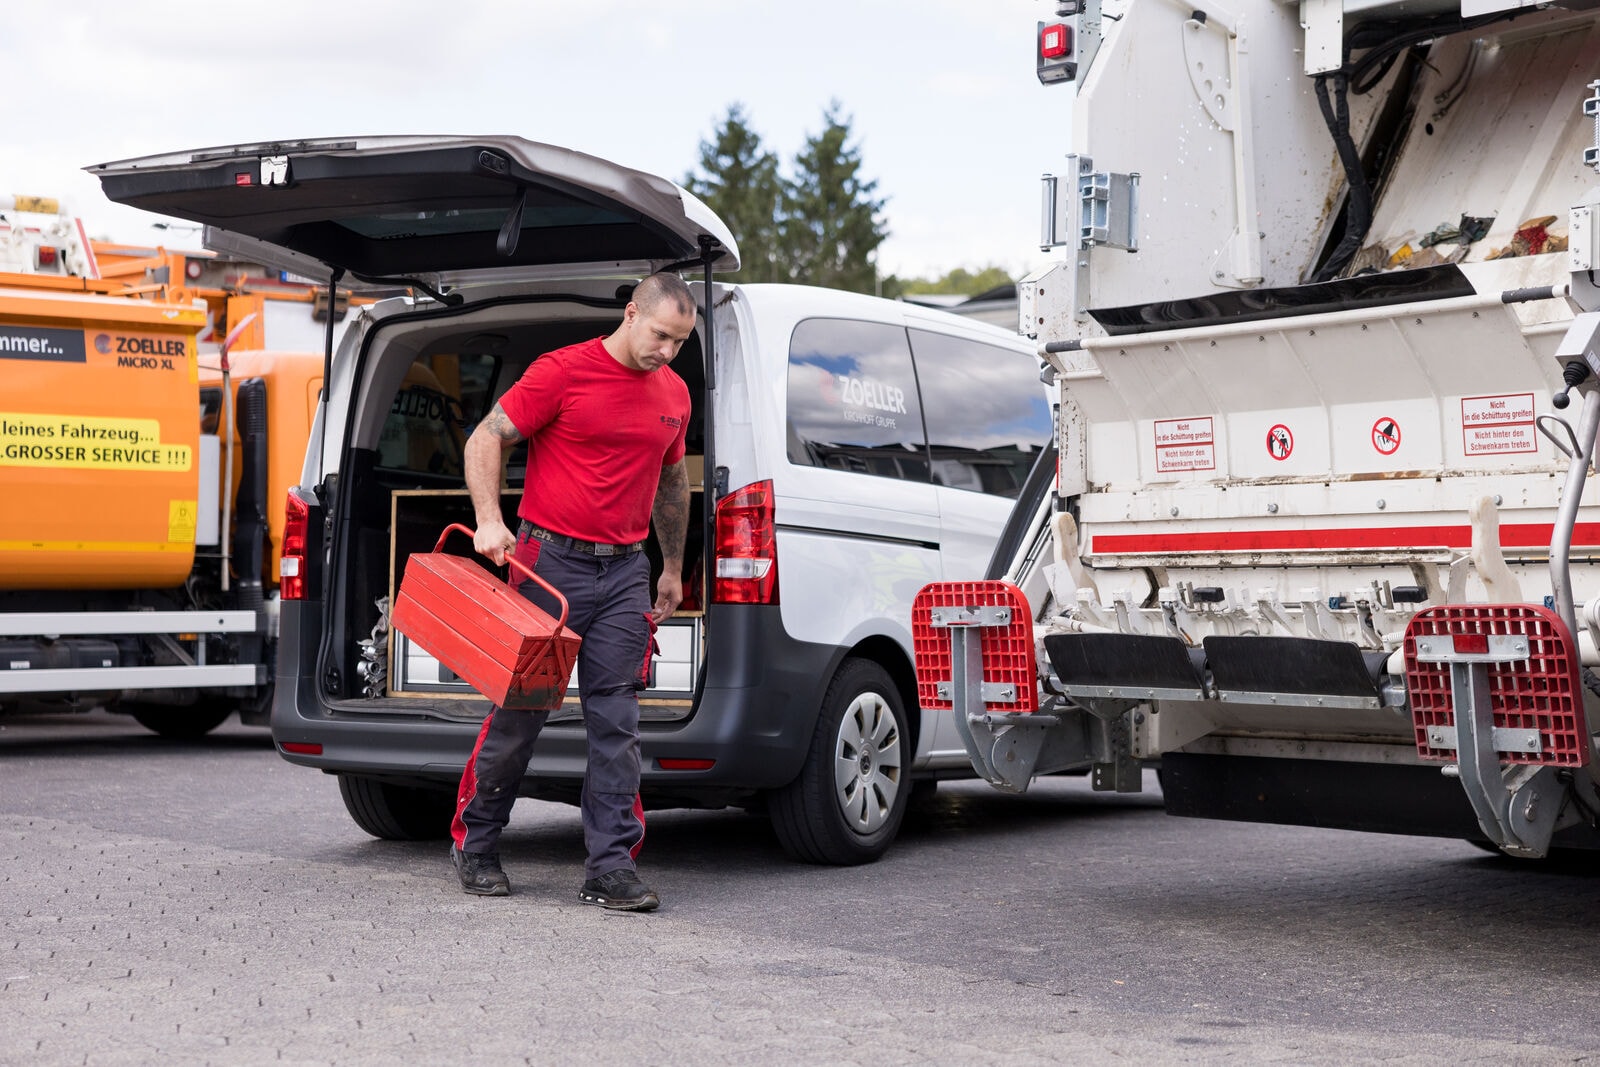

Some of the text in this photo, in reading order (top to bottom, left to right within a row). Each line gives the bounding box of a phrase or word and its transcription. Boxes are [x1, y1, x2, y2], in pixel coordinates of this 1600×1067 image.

[116, 336, 185, 357] ZOELLER
[117, 355, 175, 371] MICRO XL
[838, 375, 907, 415] ZOELLER
[1489, 401, 1505, 409] Nicht
[1464, 413, 1470, 421] in
[1471, 412, 1480, 421] die
[1512, 409, 1532, 419] greifen
[0, 420, 154, 445] leines Fahrzeug...
[1177, 423, 1190, 431] Nicht
[1162, 433, 1170, 441] die
[1195, 431, 1212, 440] greifen
[1474, 429, 1524, 439] Nicht hinter den
[1470, 440, 1531, 451] Schwenkarm treten
[92, 446, 161, 464] SERVICE
[1165, 450, 1178, 458] Nicht
[1162, 460, 1194, 468] Schwenkarm
